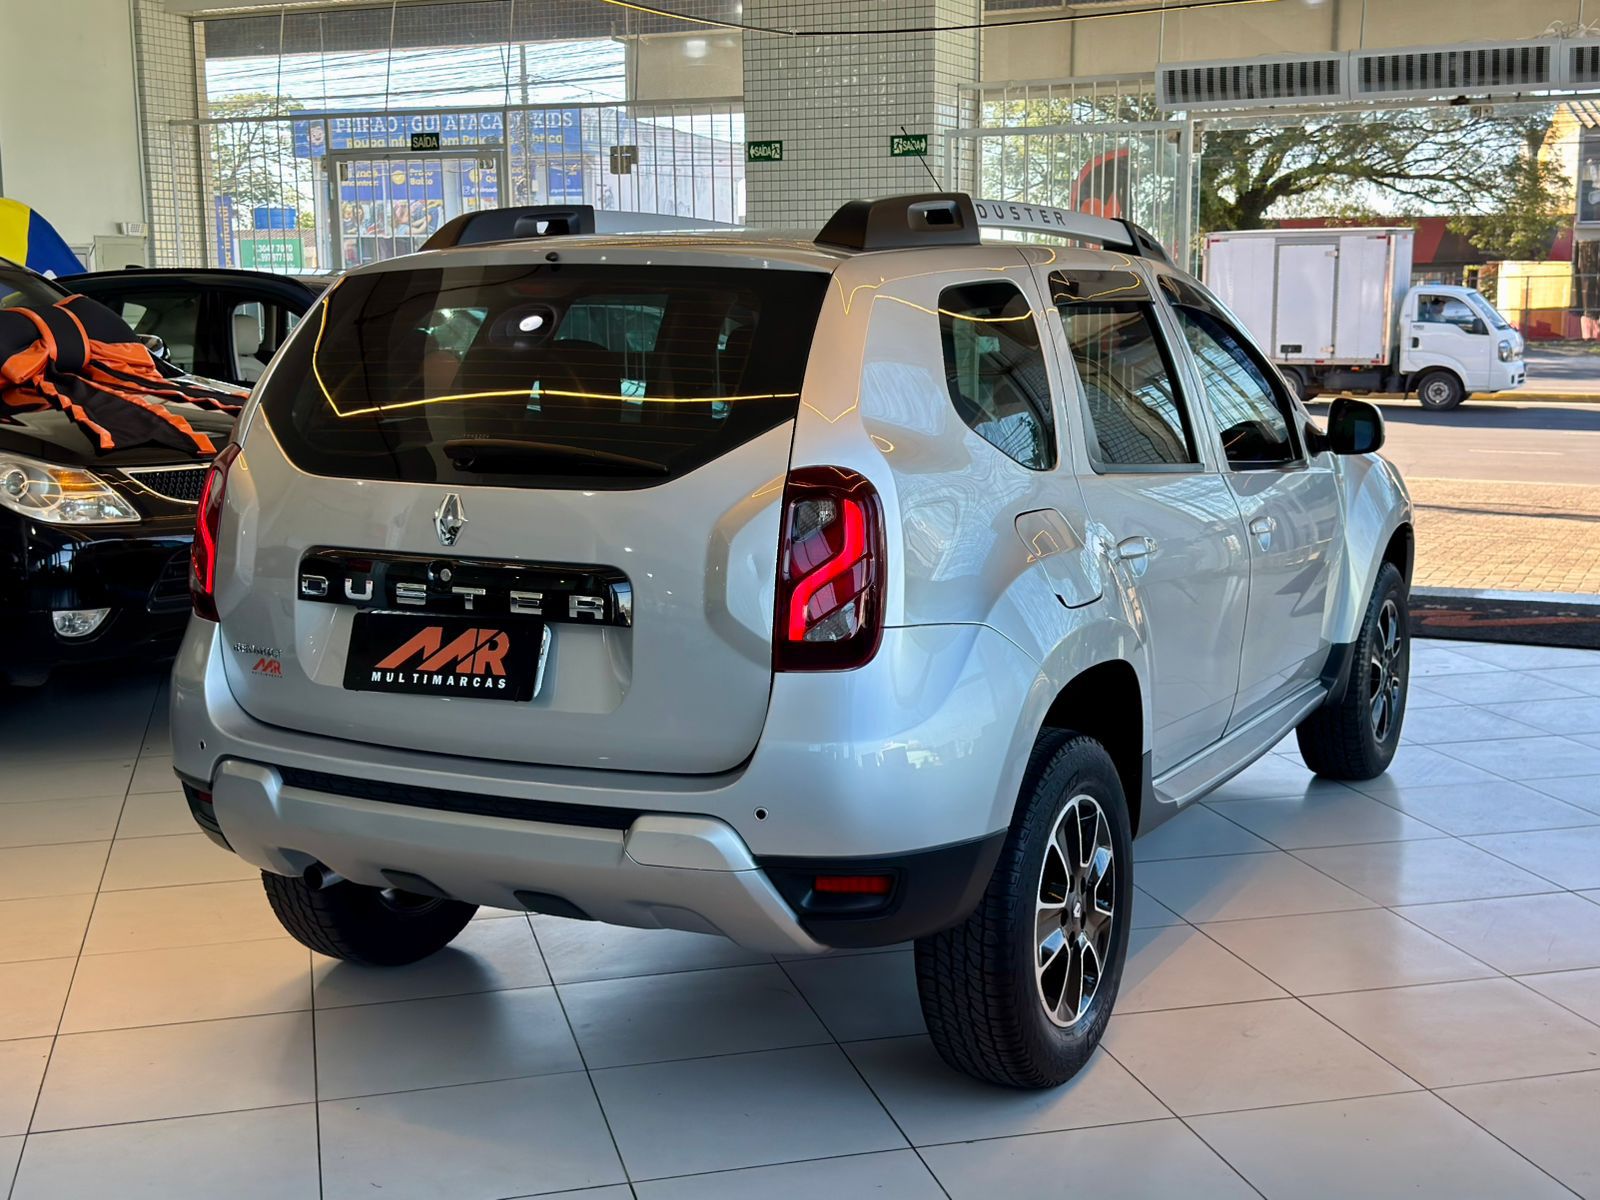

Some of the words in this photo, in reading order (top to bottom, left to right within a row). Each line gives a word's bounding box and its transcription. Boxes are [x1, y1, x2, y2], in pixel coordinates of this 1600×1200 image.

[413, 135, 437, 148] SAÍDA
[755, 145, 771, 156] SAÍDA
[976, 203, 1066, 226] DUSTER
[302, 575, 604, 619] DUSTER
[371, 671, 506, 689] MULTIMARCAS
